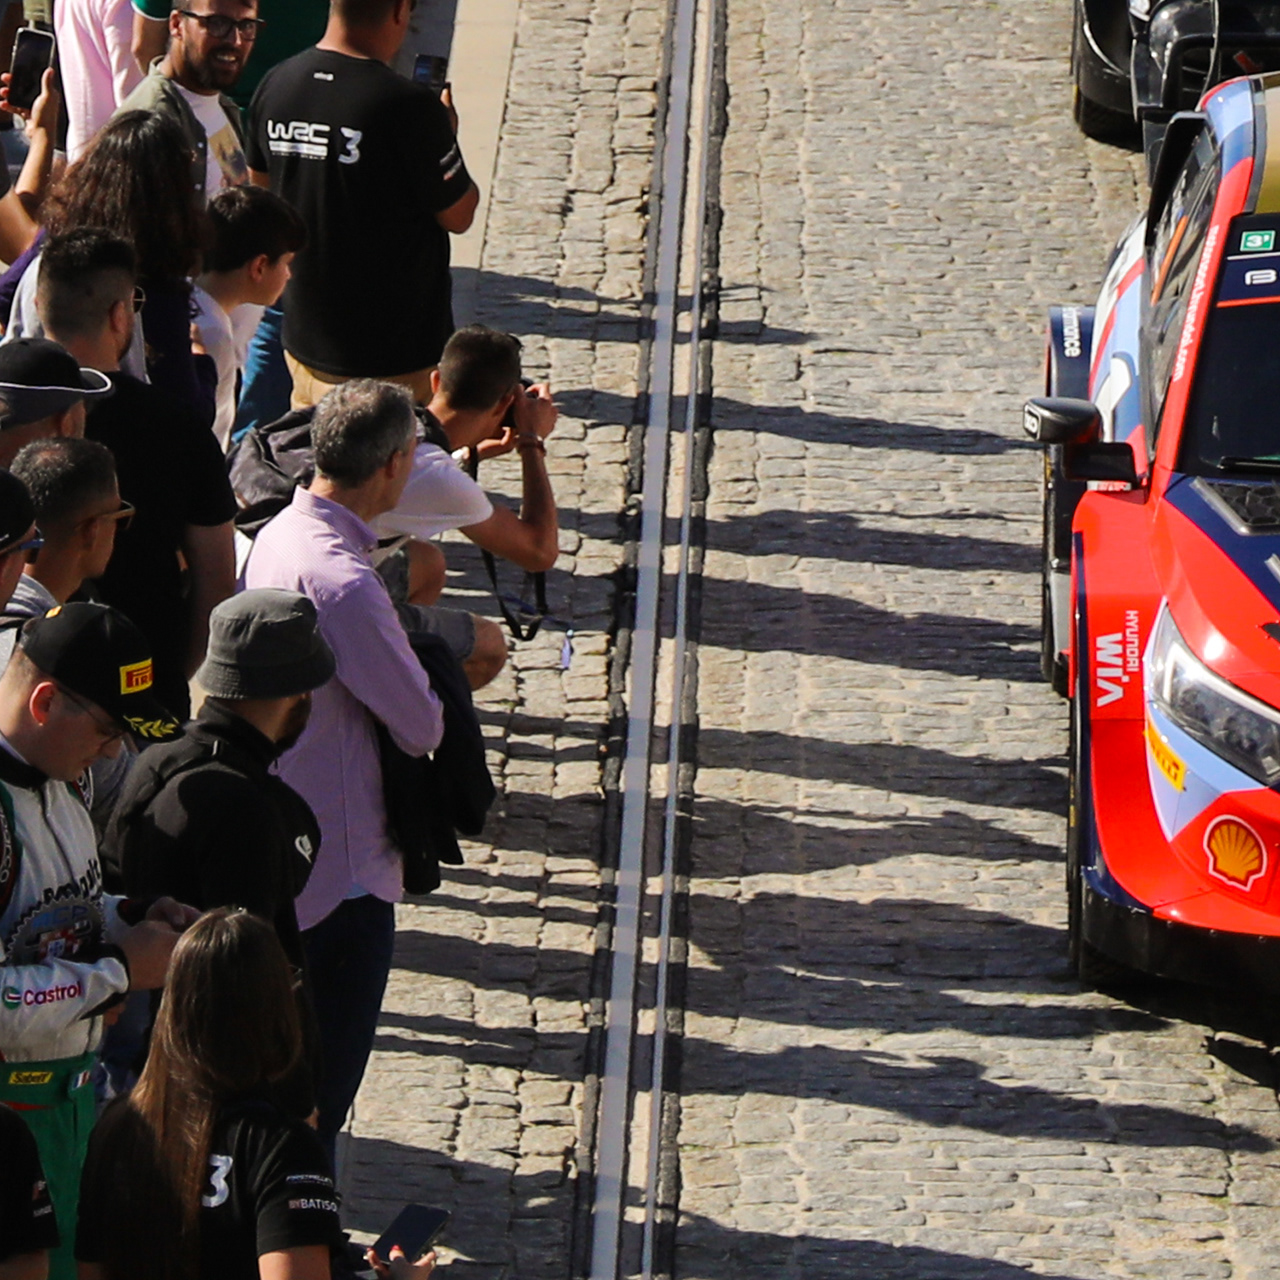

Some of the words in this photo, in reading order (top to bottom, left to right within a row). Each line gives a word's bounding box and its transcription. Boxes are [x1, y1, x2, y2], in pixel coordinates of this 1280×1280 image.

[267, 119, 331, 145] WRC
[337, 126, 363, 165] 3
[1126, 610, 1140, 672] HYUNDAI
[24, 980, 82, 1006] Castrol
[201, 1153, 233, 1208] 3
